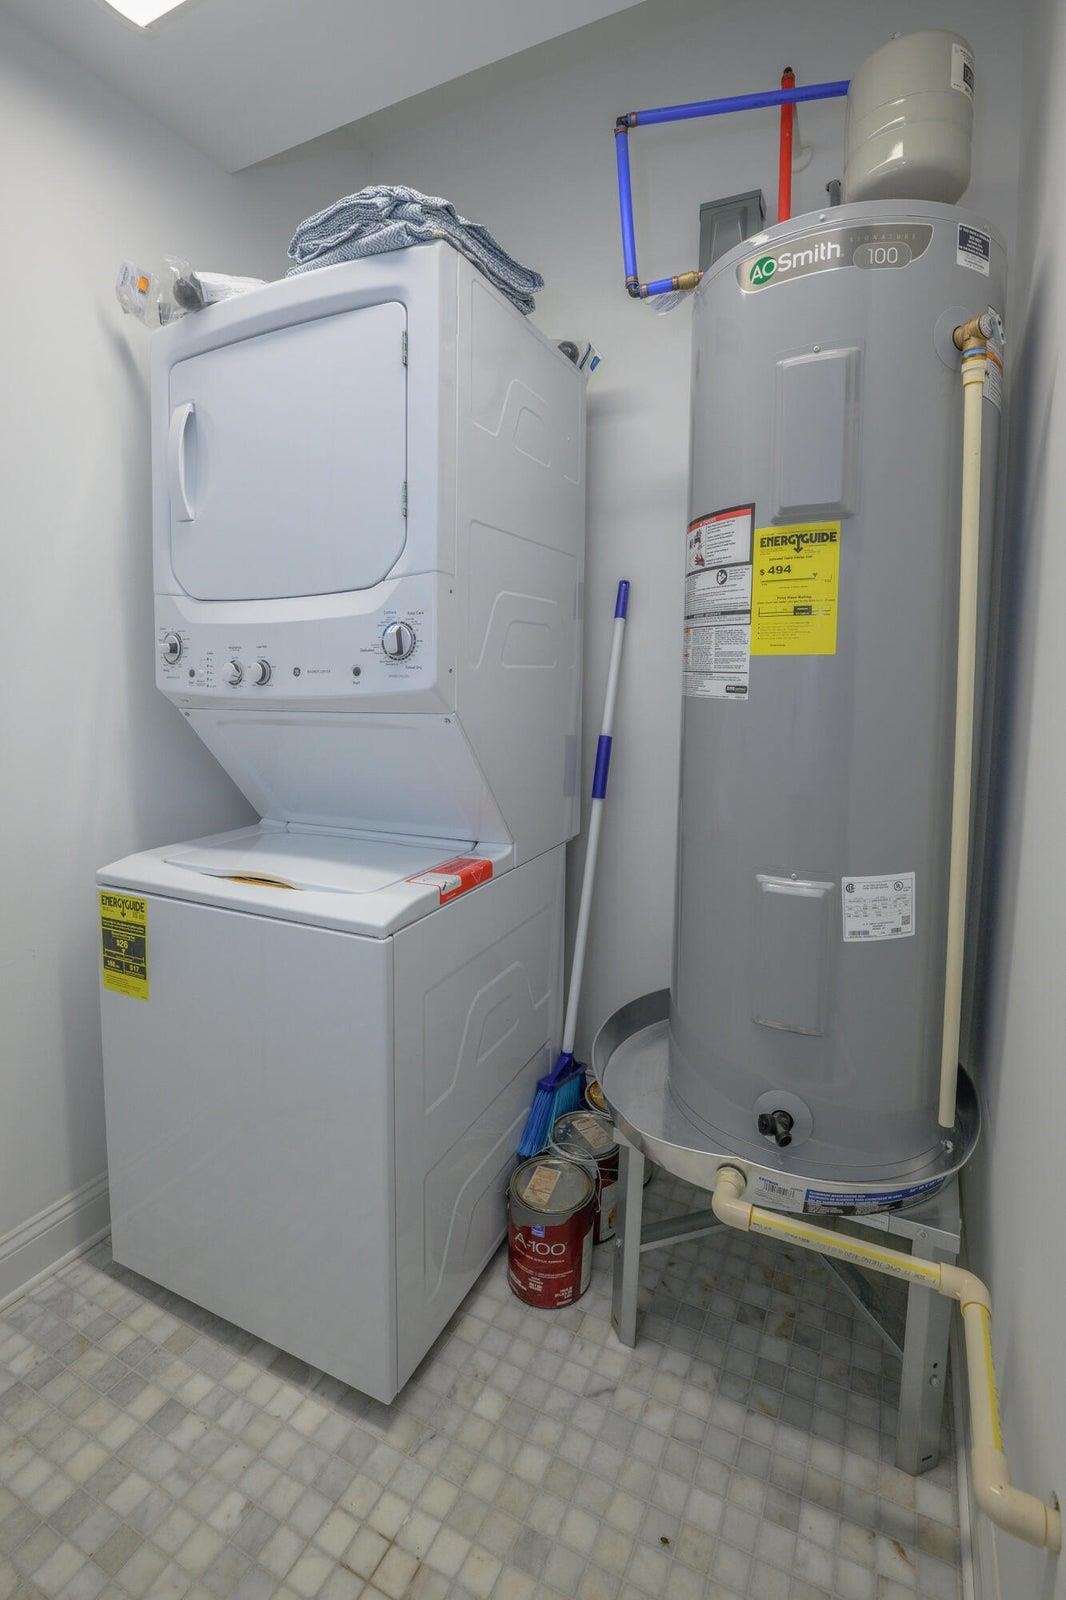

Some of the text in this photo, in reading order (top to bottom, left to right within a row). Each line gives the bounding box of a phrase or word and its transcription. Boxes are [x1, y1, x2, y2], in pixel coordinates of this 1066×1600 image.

[867, 247, 898, 265] 100
[760, 531, 838, 548] ENERGYGUIDE
[768, 564, 792, 575] 494
[101, 895, 145, 913] ENERGYGUIDE
[514, 1232, 566, 1256] A-100
